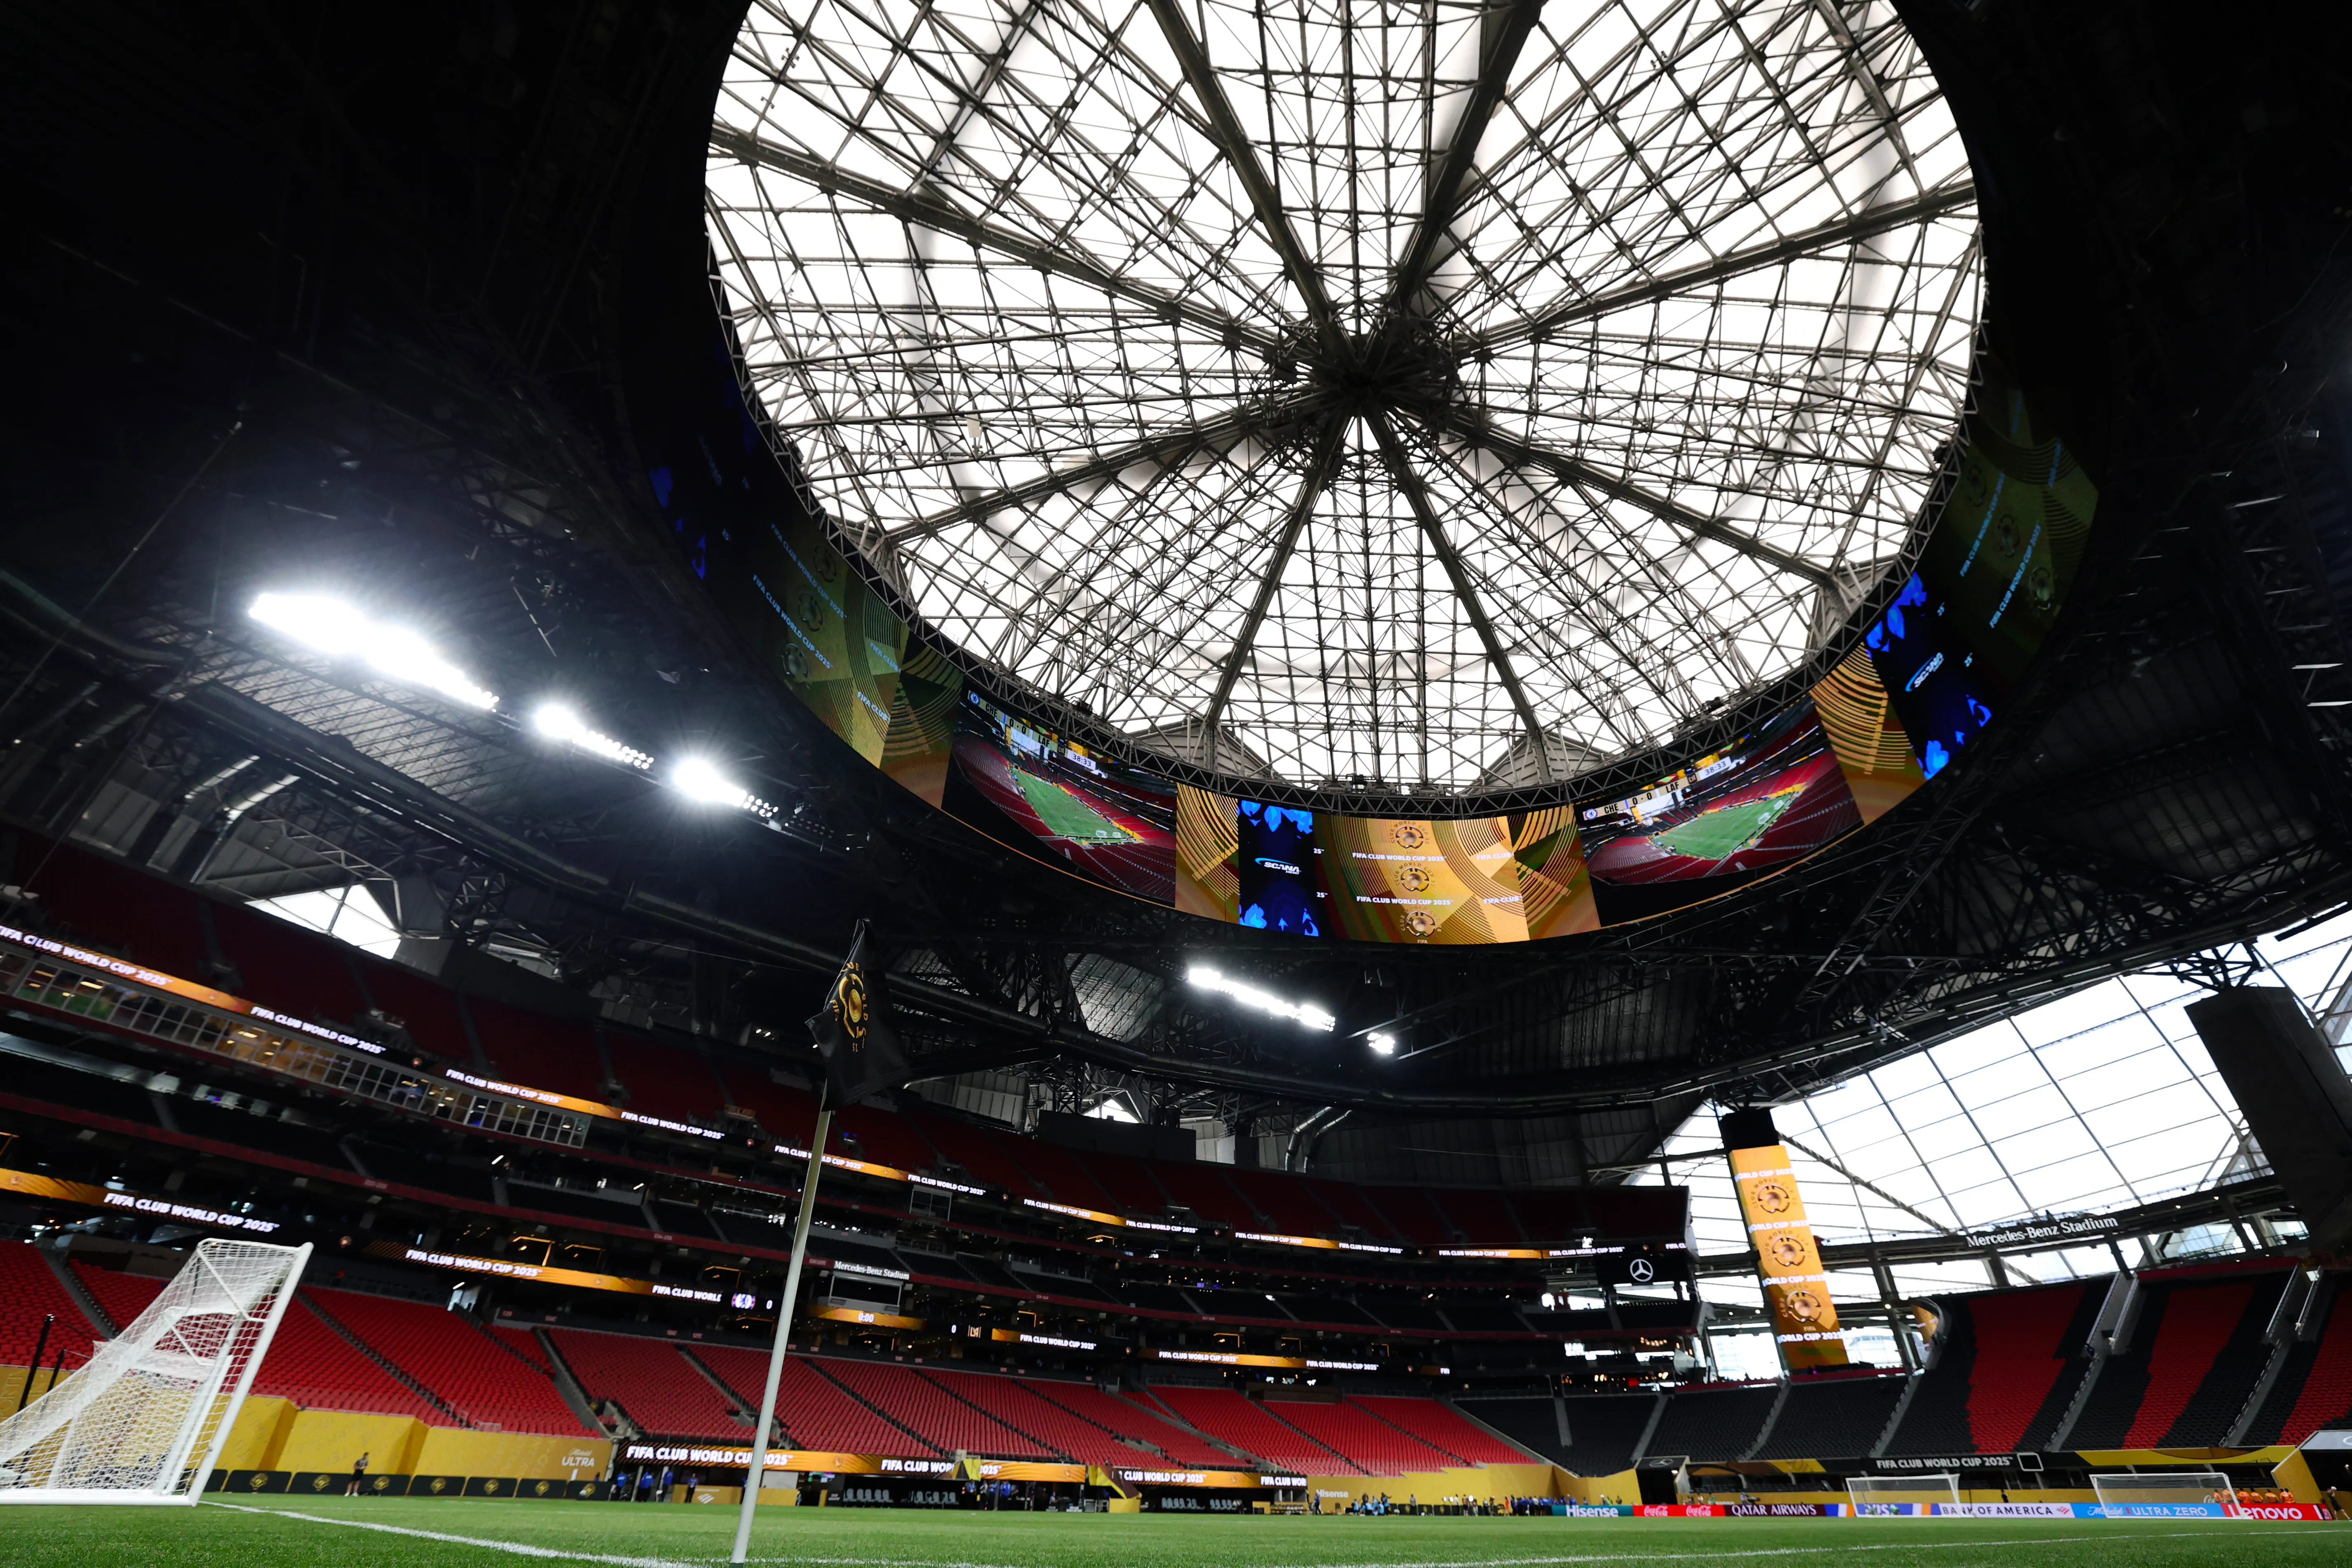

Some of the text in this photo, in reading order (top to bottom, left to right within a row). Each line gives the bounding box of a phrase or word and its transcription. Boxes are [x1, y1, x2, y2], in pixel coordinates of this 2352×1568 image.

[753, 574, 766, 594] FIFA
[765, 592, 781, 613] CLUB
[781, 610, 802, 638] WORLD
[802, 636, 816, 651] CUP
[858, 691, 889, 722] FIFA CLUB
[985, 703, 1092, 767] CHE 0 0 LAF 38:33
[1604, 803, 1619, 814] CHE
[1632, 797, 1637, 805] 0
[1665, 782, 1679, 793] LAF
[1705, 761, 1726, 776] 38:33
[1264, 862, 1300, 872] SCANA
[23, 935, 63, 953] CLUB
[63, 946, 111, 967] WORLD
[110, 962, 137, 975] CUP
[250, 1006, 275, 1020] FIFA
[274, 1014, 303, 1028] CLUB
[302, 1022, 339, 1040] WORLD
[337, 1034, 359, 1045] CUP
[446, 1069, 465, 1081] FIFA
[464, 1075, 487, 1087] CLUB
[486, 1081, 519, 1095] WORLD
[519, 1089, 538, 1098] CUP
[621, 1111, 638, 1122] FIFA
[638, 1115, 659, 1126] CLUB
[659, 1120, 687, 1132] WORLD
[687, 1126, 703, 1136] CUP
[774, 1145, 790, 1155] FIFA
[789, 1149, 808, 1159] CLUB
[831, 1158, 846, 1166] CUP
[907, 1174, 921, 1183] FIFA
[921, 1177, 937, 1186] CLUB
[936, 1180, 958, 1190] WORLD
[104, 1193, 135, 1208] FIFA
[135, 1199, 172, 1214] CLUB
[171, 1205, 219, 1222] WORLD
[217, 1214, 245, 1227] CUP
[1966, 1217, 2118, 1247] Mercedes-Benz Stadium
[405, 1249, 428, 1262] FIFA
[427, 1254, 455, 1266] CLUB
[454, 1258, 493, 1271] WORLD
[492, 1263, 514, 1274] CUP
[834, 1261, 883, 1276] Mercedes-Benz
[883, 1269, 910, 1281] Stadium
[652, 1285, 671, 1295] FIFA
[671, 1288, 694, 1299] CLUB
[766, 1300, 773, 1310] 0
[858, 1312, 874, 1323] 0:00
[952, 1325, 956, 1333] 0
[1020, 1334, 1033, 1343] FIFA
[1033, 1336, 1048, 1344] CLUB
[1048, 1338, 1069, 1347] WORLD
[561, 1456, 595, 1467] ULTRA
[626, 1446, 655, 1459] FIFA
[656, 1447, 688, 1461] CLUB
[690, 1449, 734, 1463] WORLD
[881, 1459, 903, 1471] FIFA
[904, 1461, 929, 1472] CLUB
[1876, 1459, 1898, 1469] FIFA
[1898, 1459, 1923, 1468] CLUB
[1923, 1458, 1960, 1468] WORLD
[1961, 1457, 1982, 1467] CUP
[1124, 1471, 1143, 1481] CLUB
[1144, 1472, 1170, 1482] WORLD
[1171, 1473, 1186, 1483] CUP
[1260, 1476, 1274, 1486] FIFA
[1274, 1477, 1291, 1486] CLUB
[1316, 1489, 1349, 1498] Hisense
[1566, 1505, 1619, 1517] Hisense
[1731, 1504, 1817, 1517] QATAR AIRWAYS
[1978, 1506, 1992, 1515] OF
[1997, 1506, 2053, 1515] AMERICA
[2132, 1506, 2171, 1517] ULTRA
[2173, 1506, 2208, 1517] ZERO
[2228, 1505, 2303, 1520] Lenovo
